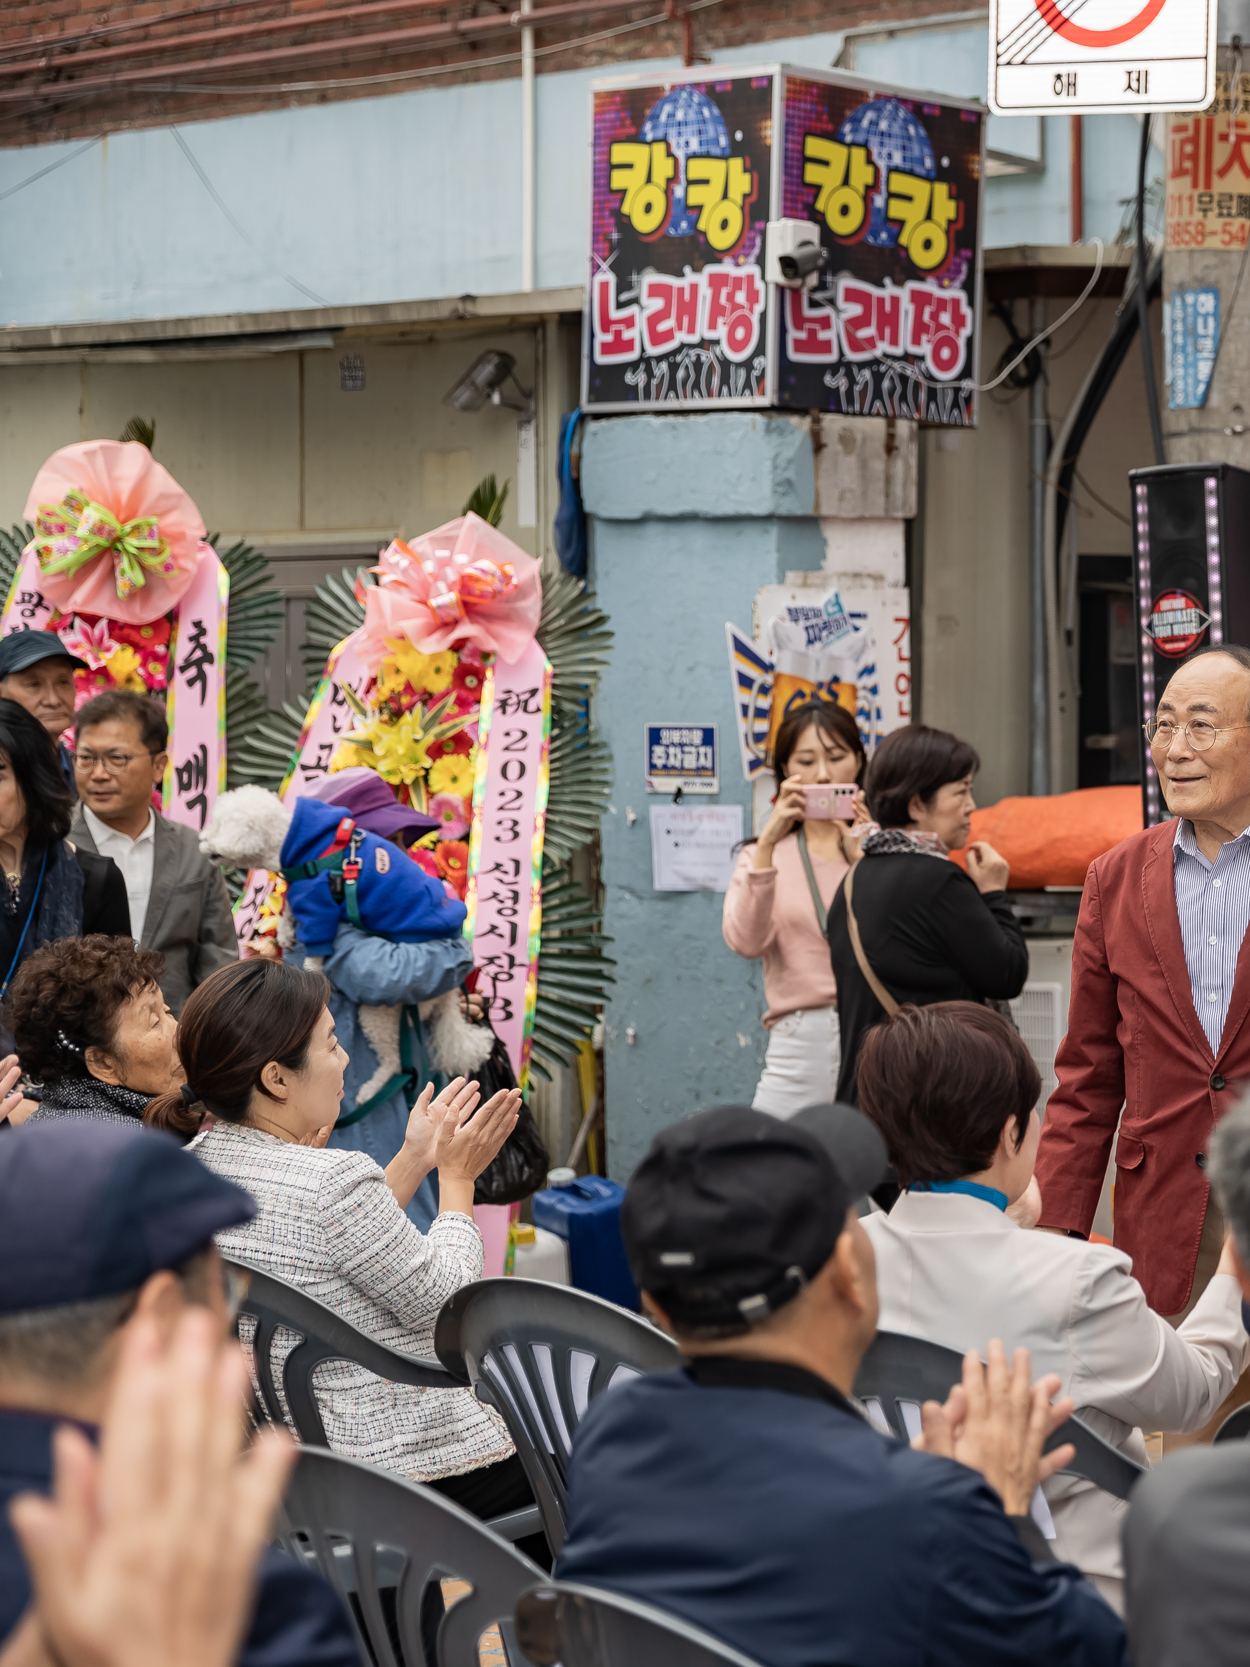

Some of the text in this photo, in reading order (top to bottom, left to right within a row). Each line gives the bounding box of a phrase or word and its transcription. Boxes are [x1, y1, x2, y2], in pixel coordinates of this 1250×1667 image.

[610, 141, 752, 251] 캉캉
[804, 135, 957, 270] 캉캉
[597, 269, 763, 358] 노래짱
[787, 285, 968, 373] 노래짱
[651, 745, 713, 769] 주차금지
